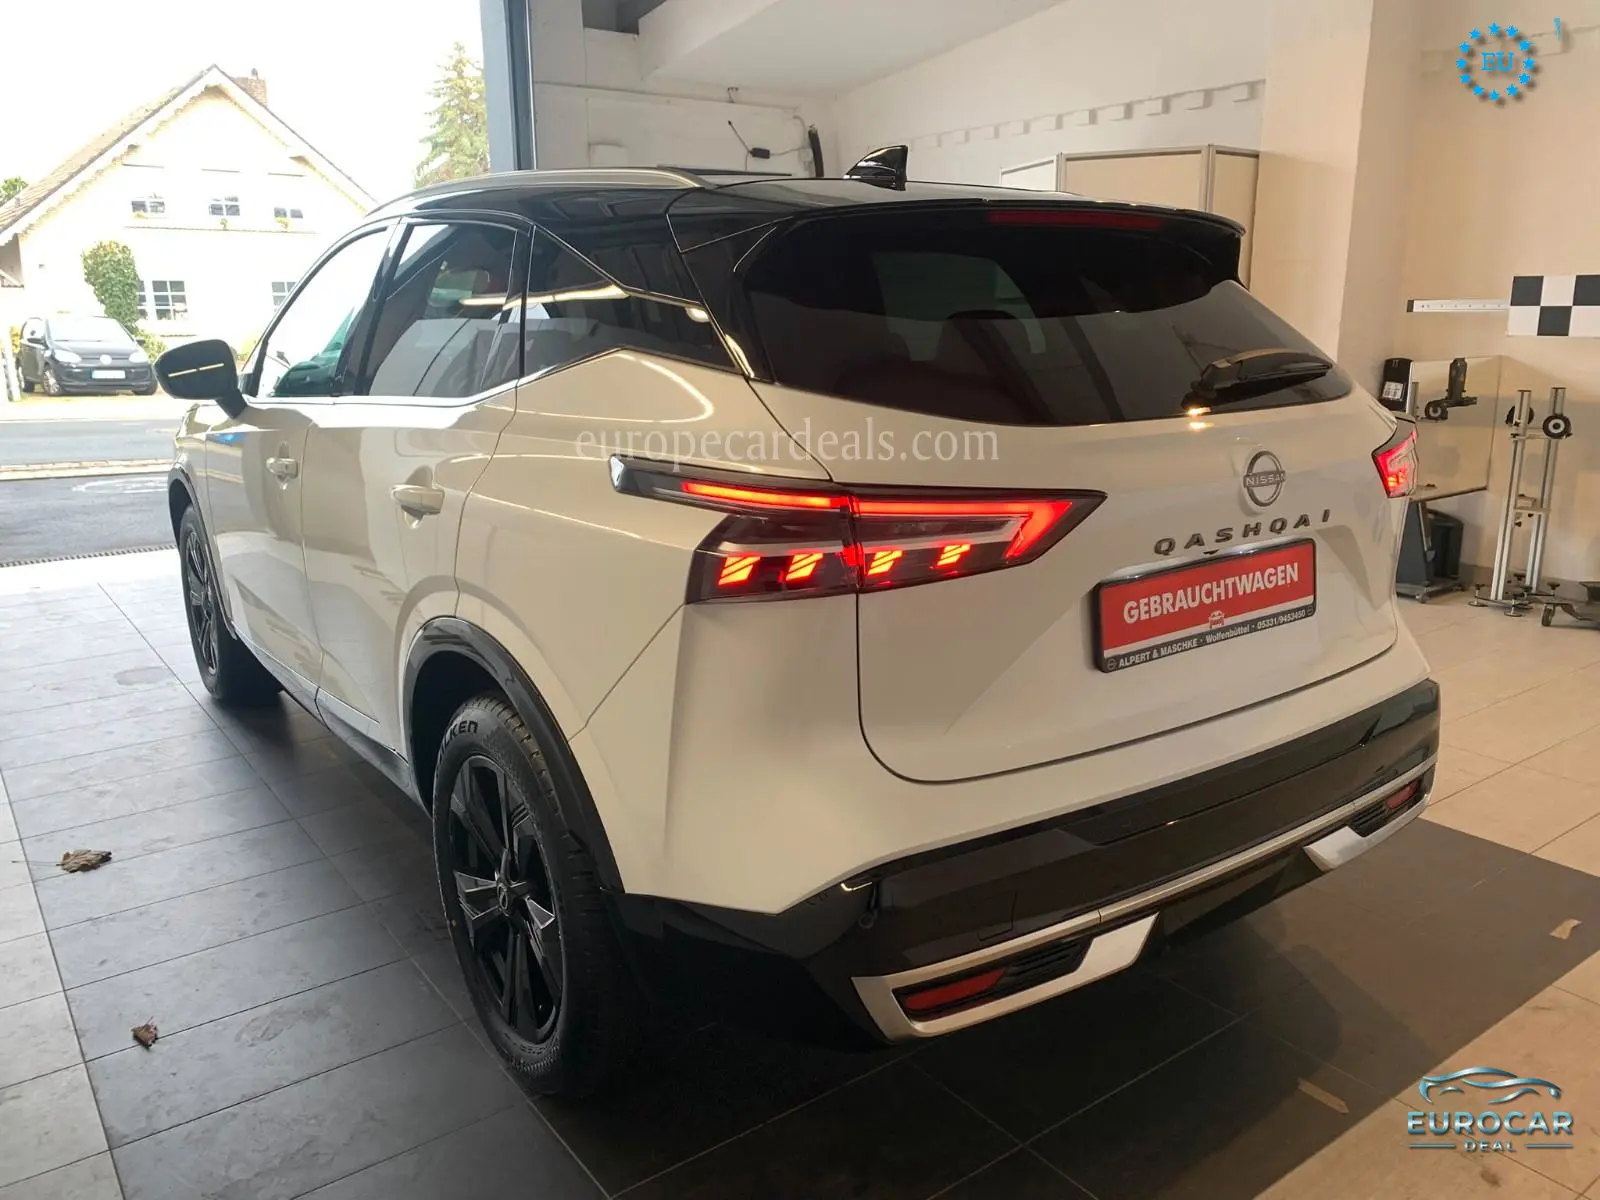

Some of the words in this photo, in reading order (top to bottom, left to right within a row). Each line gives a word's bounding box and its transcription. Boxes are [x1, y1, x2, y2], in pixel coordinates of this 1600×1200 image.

[1245, 471, 1286, 487] NISSAN
[1153, 508, 1331, 556] QASHQAI
[1122, 562, 1299, 624] GEBRAUCHTWAGEN
[1118, 651, 1151, 668] ALPERT
[1152, 649, 1160, 659] &
[1160, 638, 1198, 657] MASCHKE
[1205, 624, 1250, 643] Wolfenbüttel
